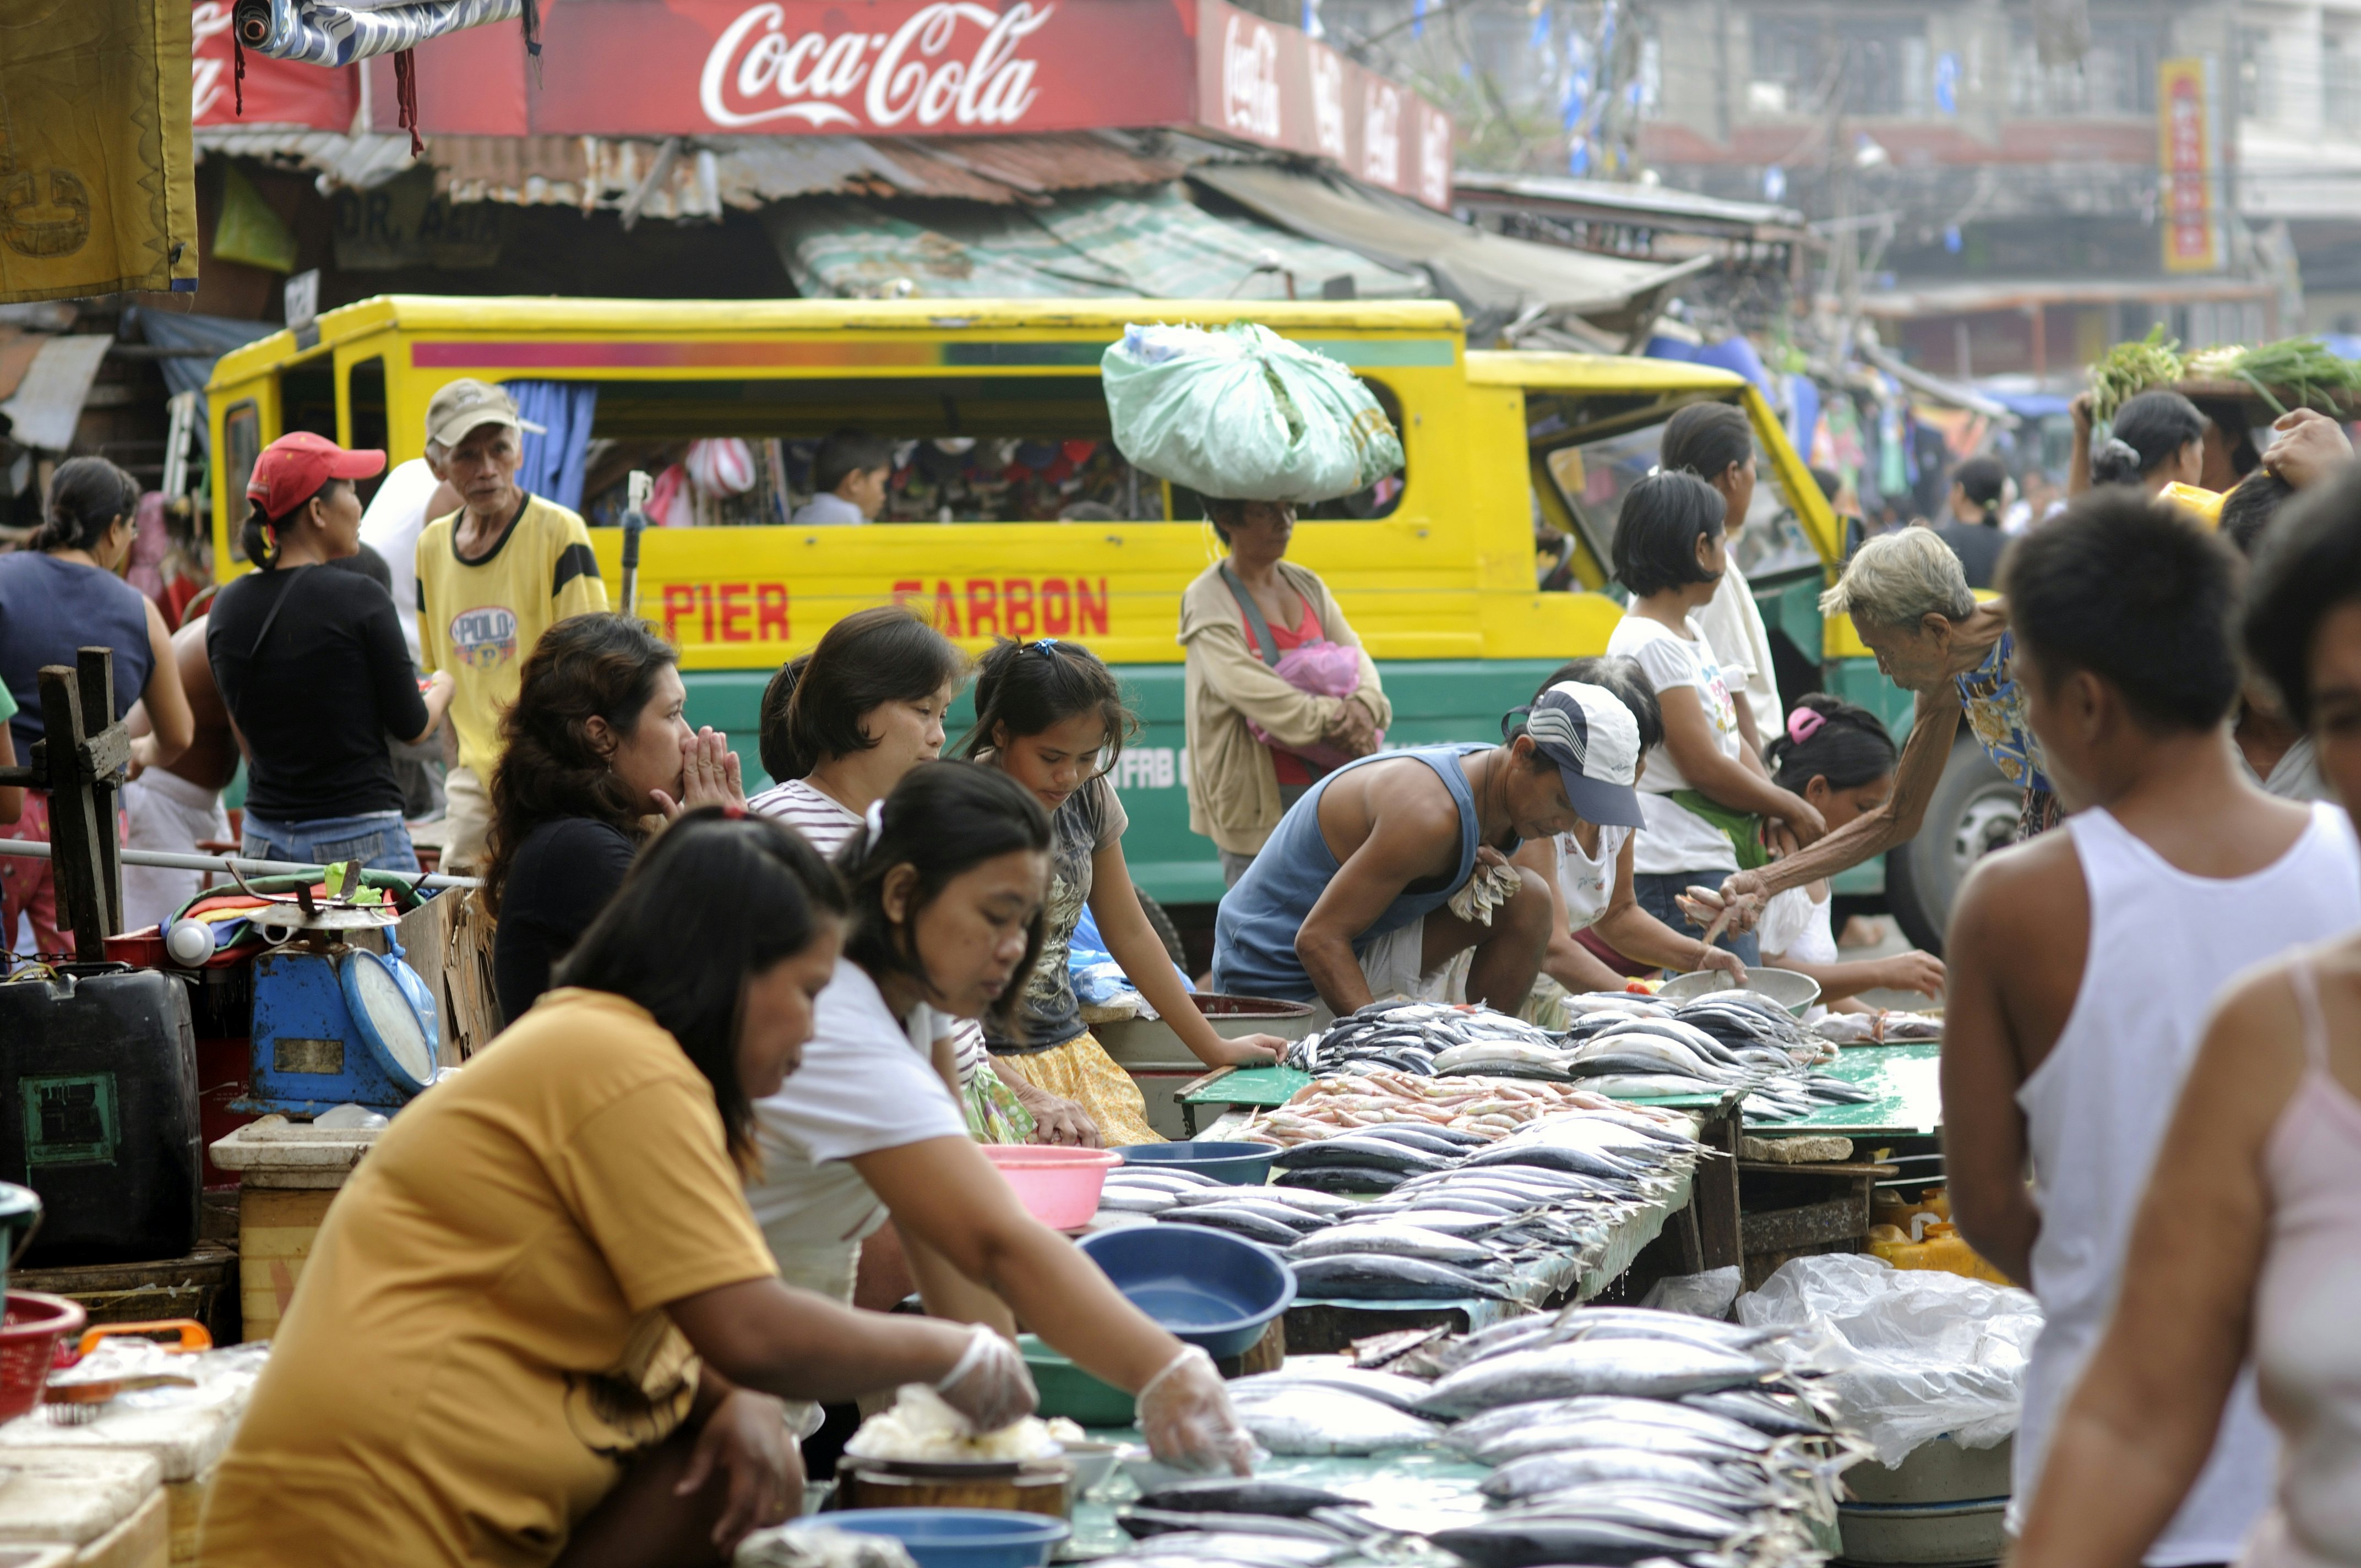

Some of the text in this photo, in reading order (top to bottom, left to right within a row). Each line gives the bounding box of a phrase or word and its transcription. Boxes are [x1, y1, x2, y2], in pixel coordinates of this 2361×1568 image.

[699, 2, 1055, 128] Coca-Cola
[458, 613, 510, 643] POLO
[663, 584, 790, 643] PIER
